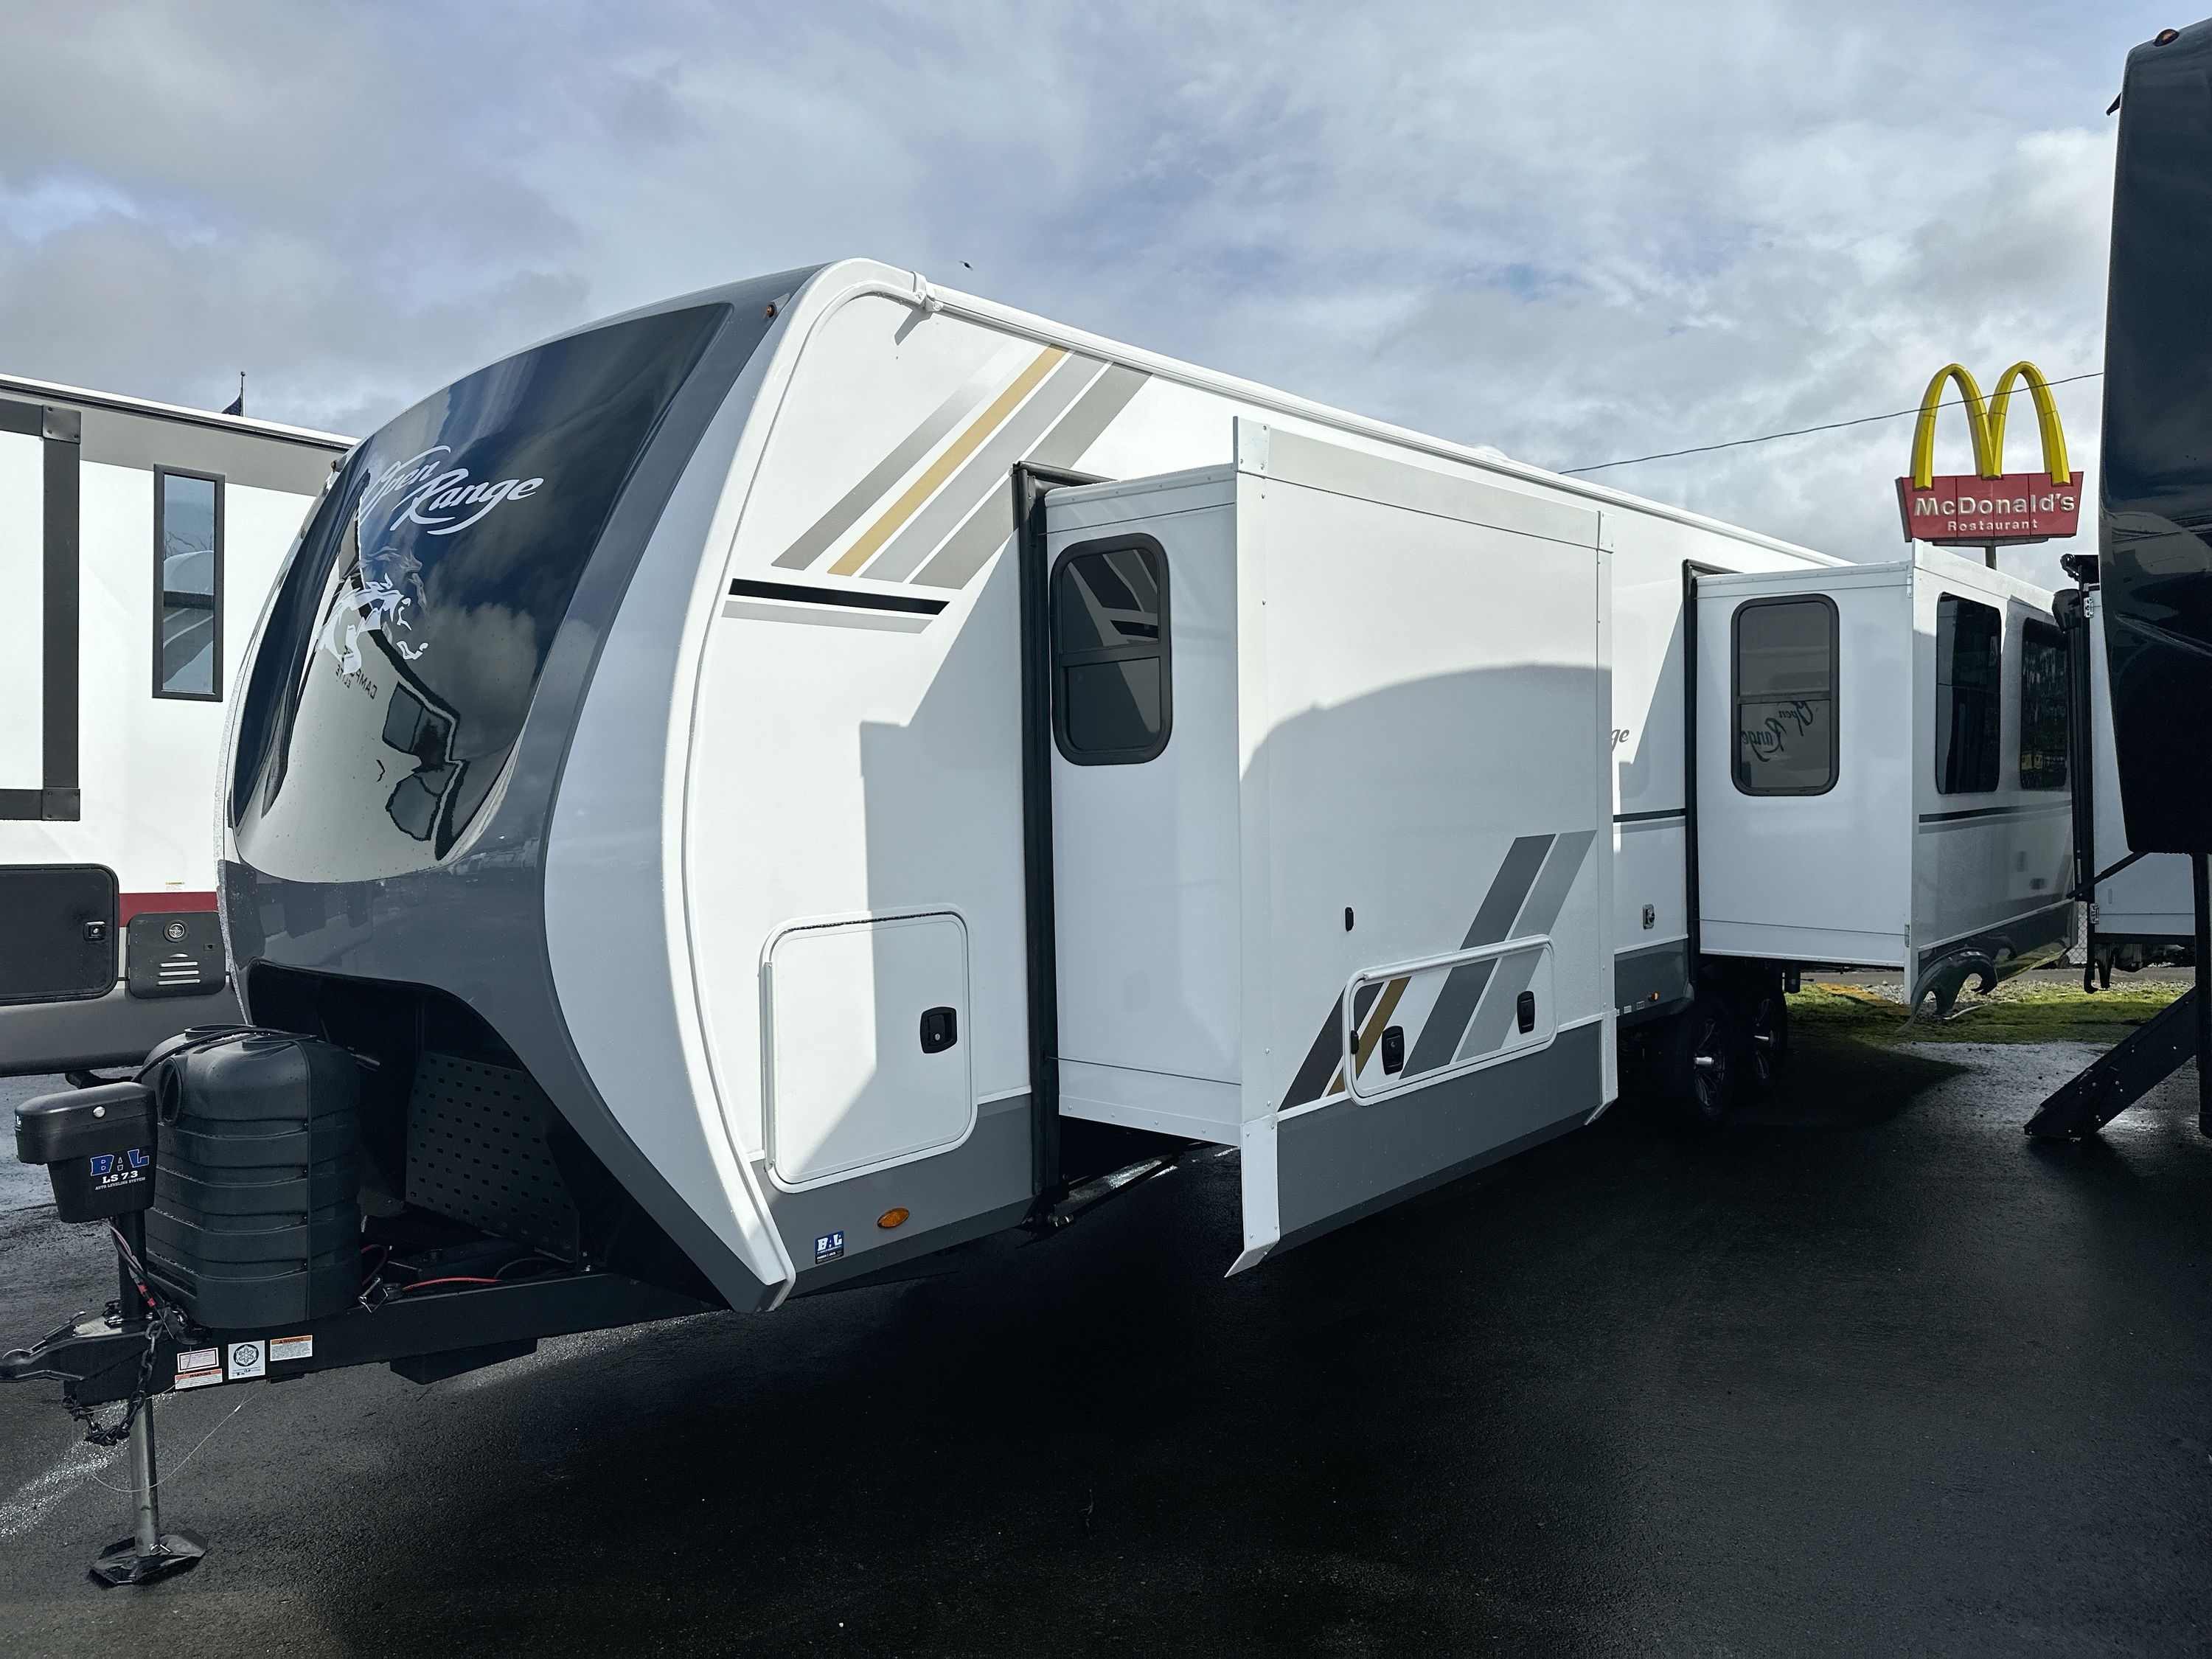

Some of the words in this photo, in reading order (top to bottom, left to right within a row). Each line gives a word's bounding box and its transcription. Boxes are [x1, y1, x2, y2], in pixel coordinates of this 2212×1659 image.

[353, 445, 451, 525] Open
[389, 467, 544, 535] Range
[1914, 493, 2076, 516] McDonald's
[1947, 518, 2038, 532] Restaurant
[91, 1149, 149, 1176] BAL
[102, 1174, 118, 1183] LS
